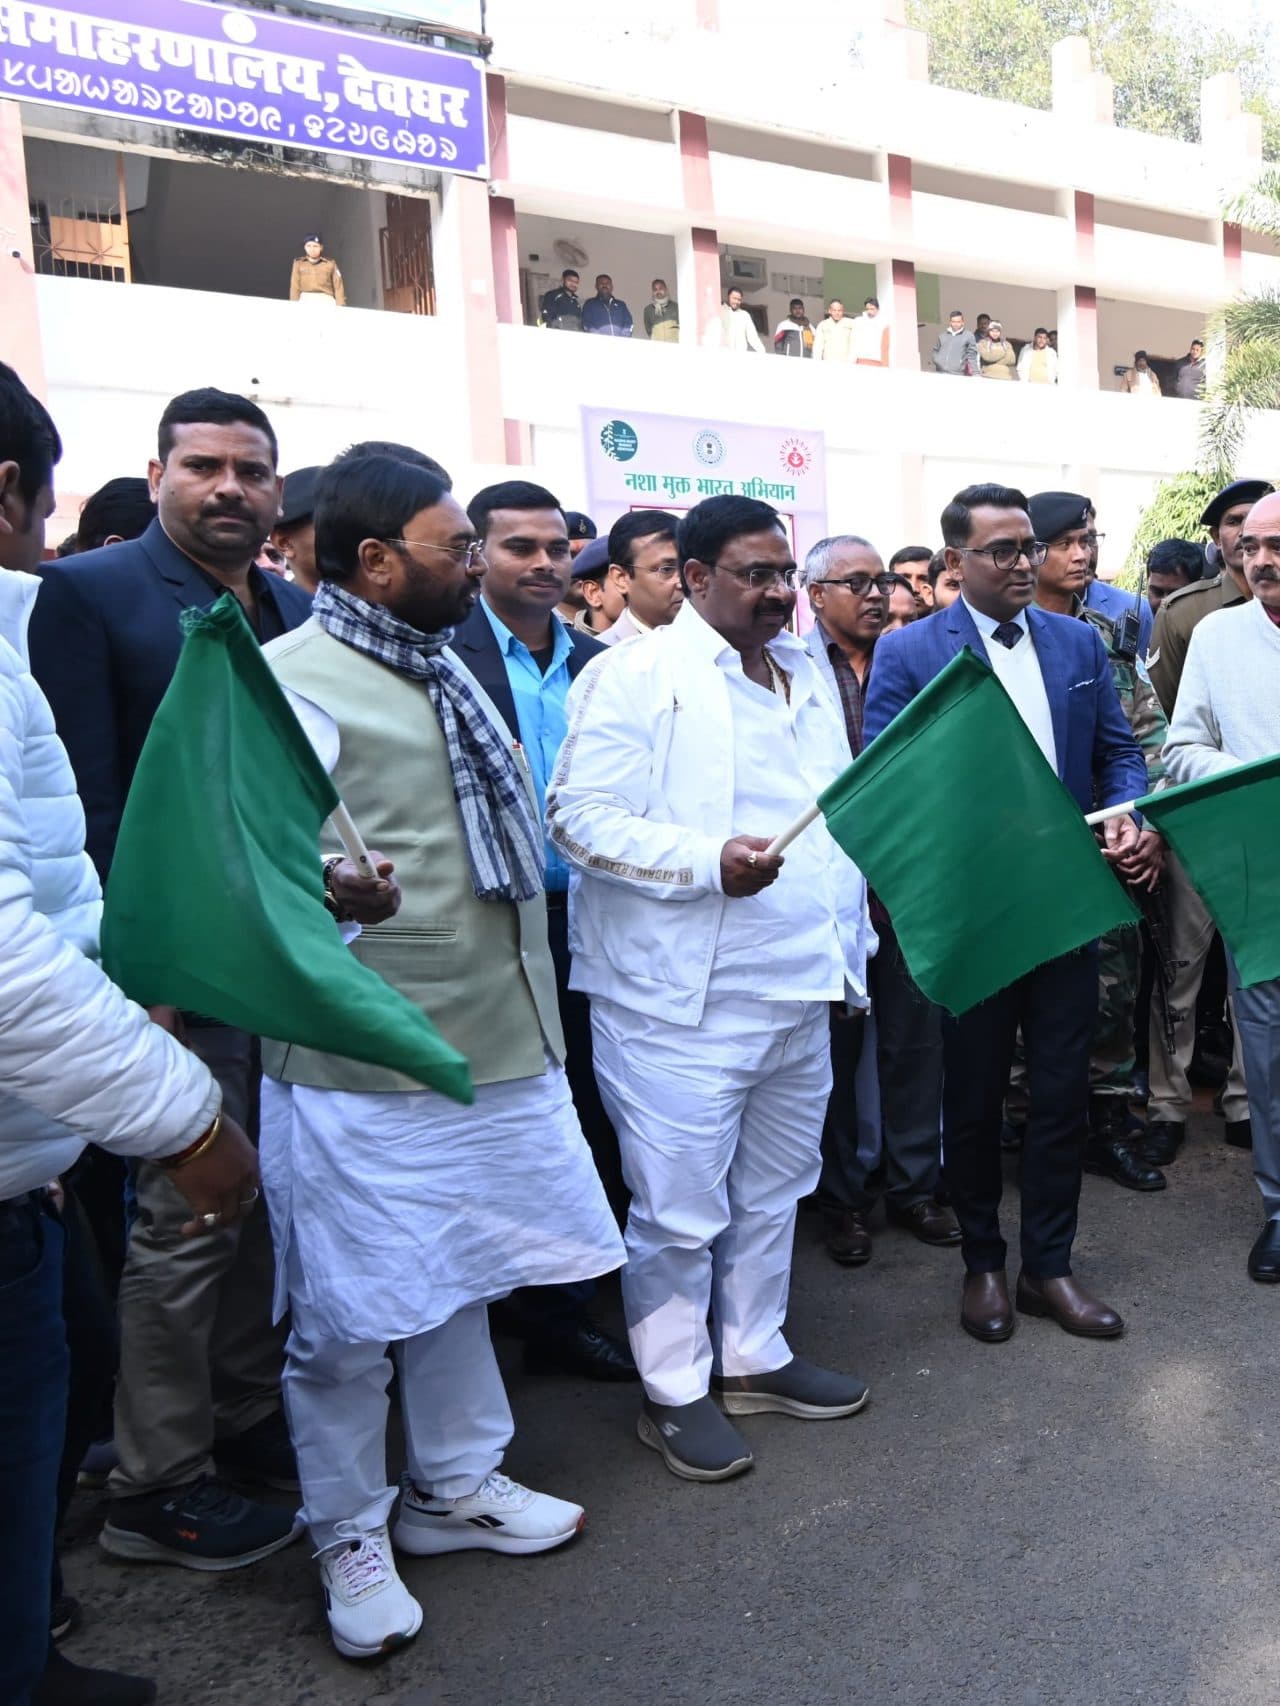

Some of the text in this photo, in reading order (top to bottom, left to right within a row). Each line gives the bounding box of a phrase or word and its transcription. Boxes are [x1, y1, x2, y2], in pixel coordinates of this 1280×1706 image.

[624, 473, 795, 500] नशा मुक्त भारत अभियान
